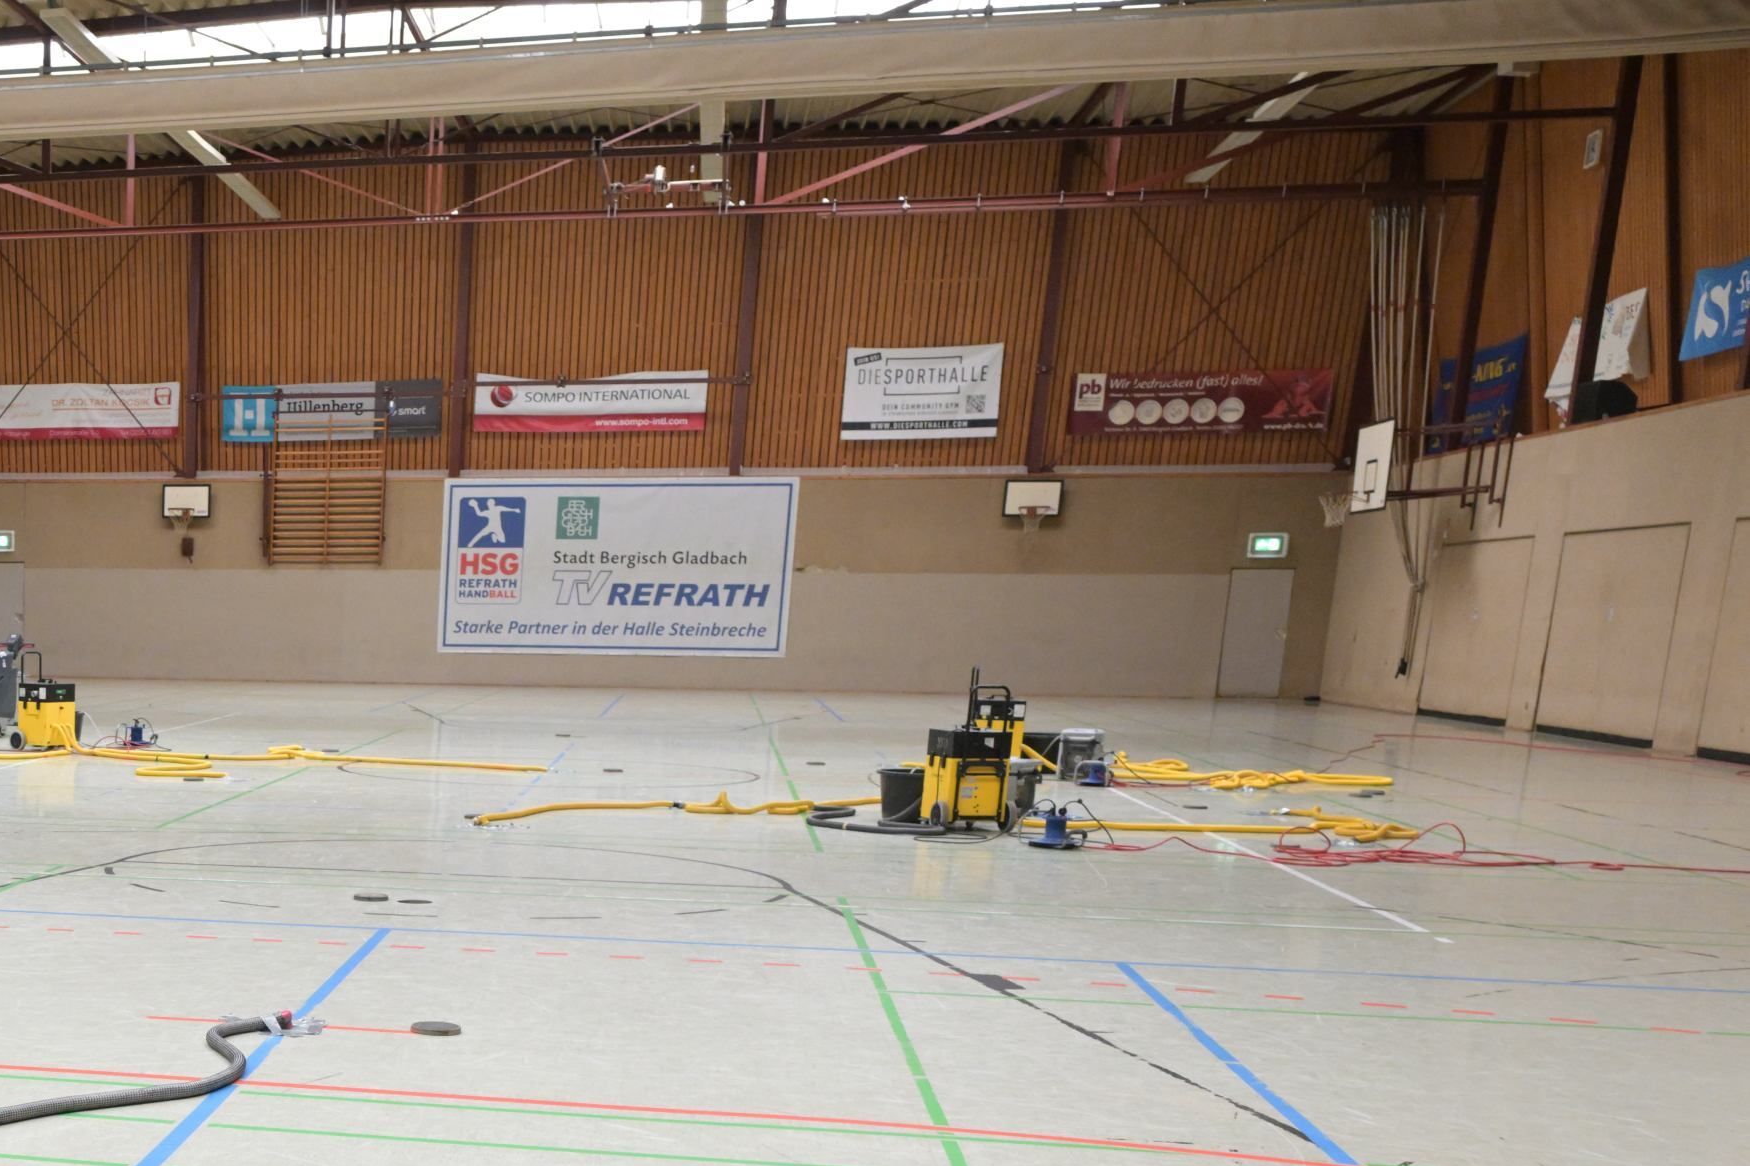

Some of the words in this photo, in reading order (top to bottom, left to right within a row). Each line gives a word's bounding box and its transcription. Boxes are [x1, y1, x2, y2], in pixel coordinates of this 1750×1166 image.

[858, 364, 989, 385] DIESPORTHALLE
[1108, 378, 1131, 389] Wir
[1132, 377, 1194, 389] bedrucken
[1195, 375, 1230, 390] (fast)
[1231, 374, 1263, 387] alles!
[524, 391, 576, 404] SOMPO
[578, 388, 691, 402] INTERNATIONAL
[1078, 379, 1102, 399] pb
[70, 398, 108, 407] ZOLTAN
[286, 399, 364, 416] Hillenberg
[397, 405, 426, 416] smart
[594, 417, 688, 428] www.sompo-intl.com
[870, 420, 969, 430] WWW.DIESPORTHALLE.COM
[459, 552, 520, 576] HSG
[553, 550, 595, 564] Stadt
[600, 551, 667, 568] Bergisch
[672, 551, 748, 565] Gladbach
[458, 578, 518, 589] REFRATH
[552, 570, 613, 605] TV
[606, 582, 770, 607] REFRATH
[458, 589, 517, 599] HANDBALL
[453, 620, 503, 634] Starke
[507, 620, 569, 635] Partner
[571, 621, 587, 635] in
[591, 621, 619, 635] der
[623, 622, 665, 636] Halle
[668, 622, 768, 637] Steinbreche
